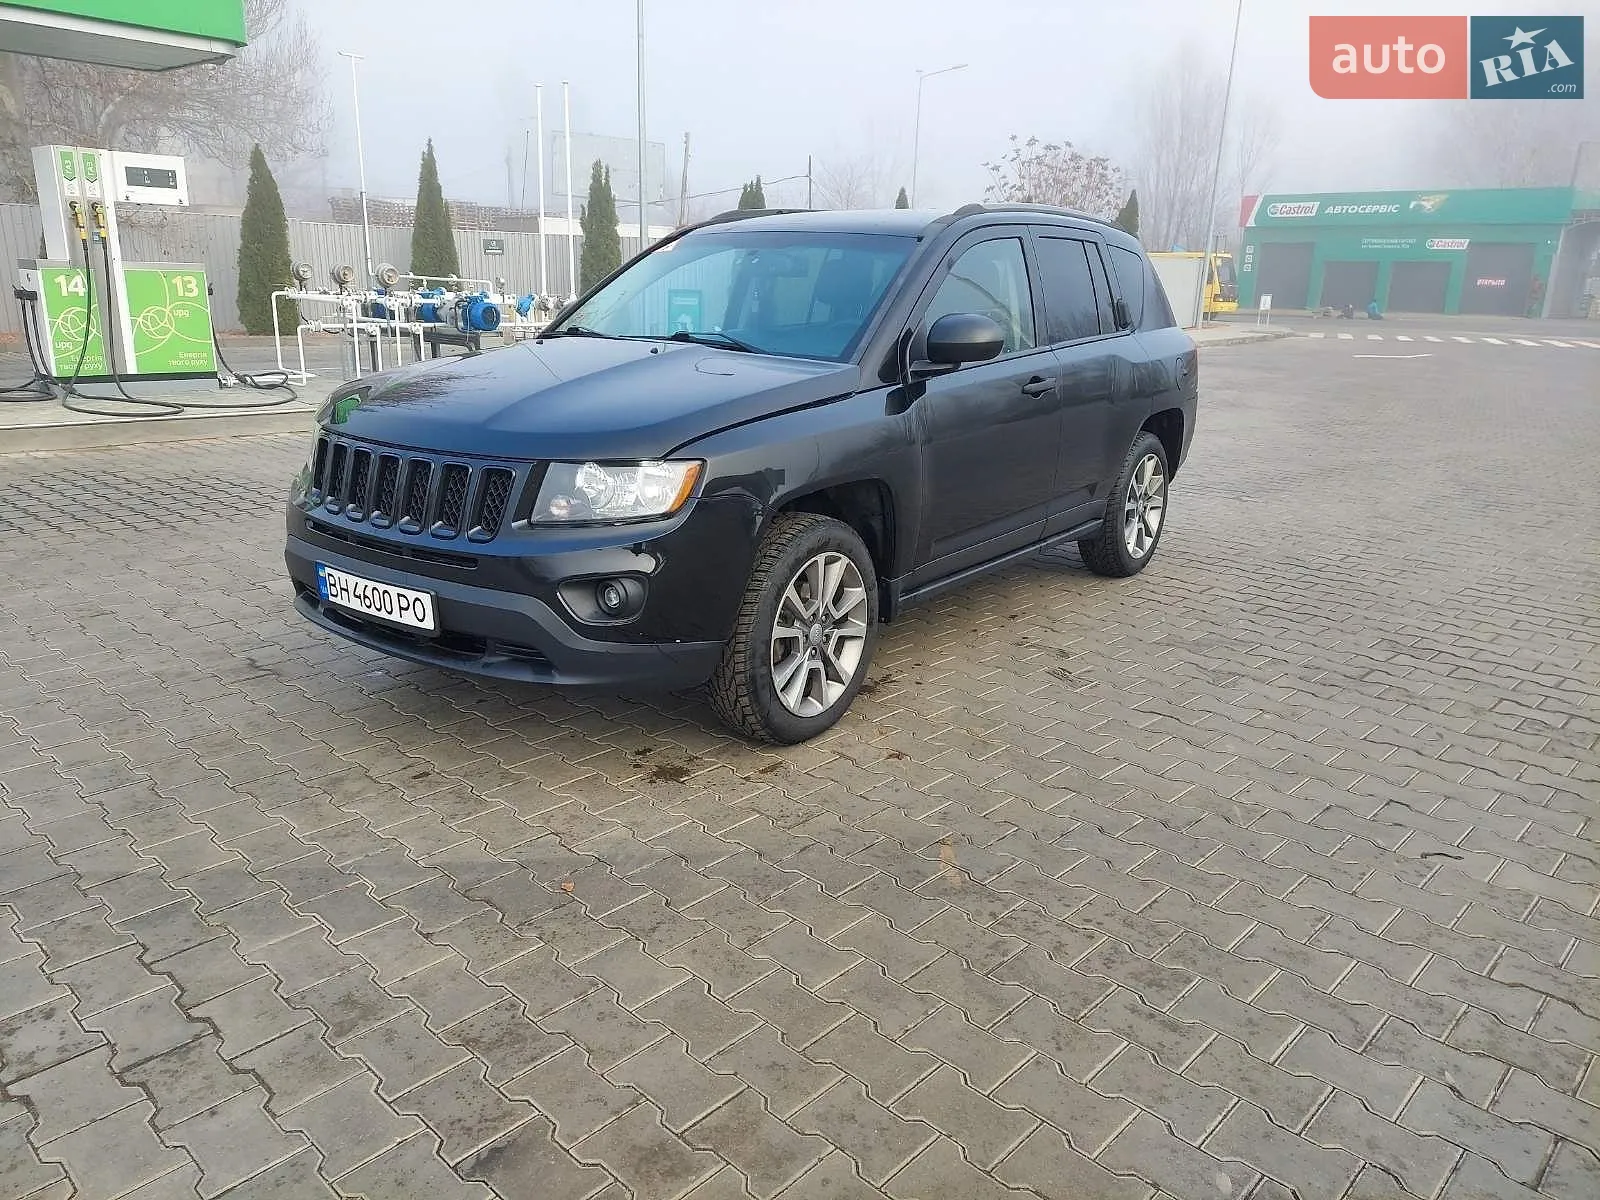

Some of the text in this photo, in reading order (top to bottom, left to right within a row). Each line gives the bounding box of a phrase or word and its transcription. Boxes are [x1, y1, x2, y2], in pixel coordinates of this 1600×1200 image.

[1278, 203, 1315, 216] Castrol
[1325, 204, 1400, 214] АВТОСЕРВІС
[55, 274, 86, 297] 14
[172, 275, 199, 298] 13
[173, 309, 190, 317] upg
[55, 341, 73, 350] upg
[353, 581, 393, 615] 4600
